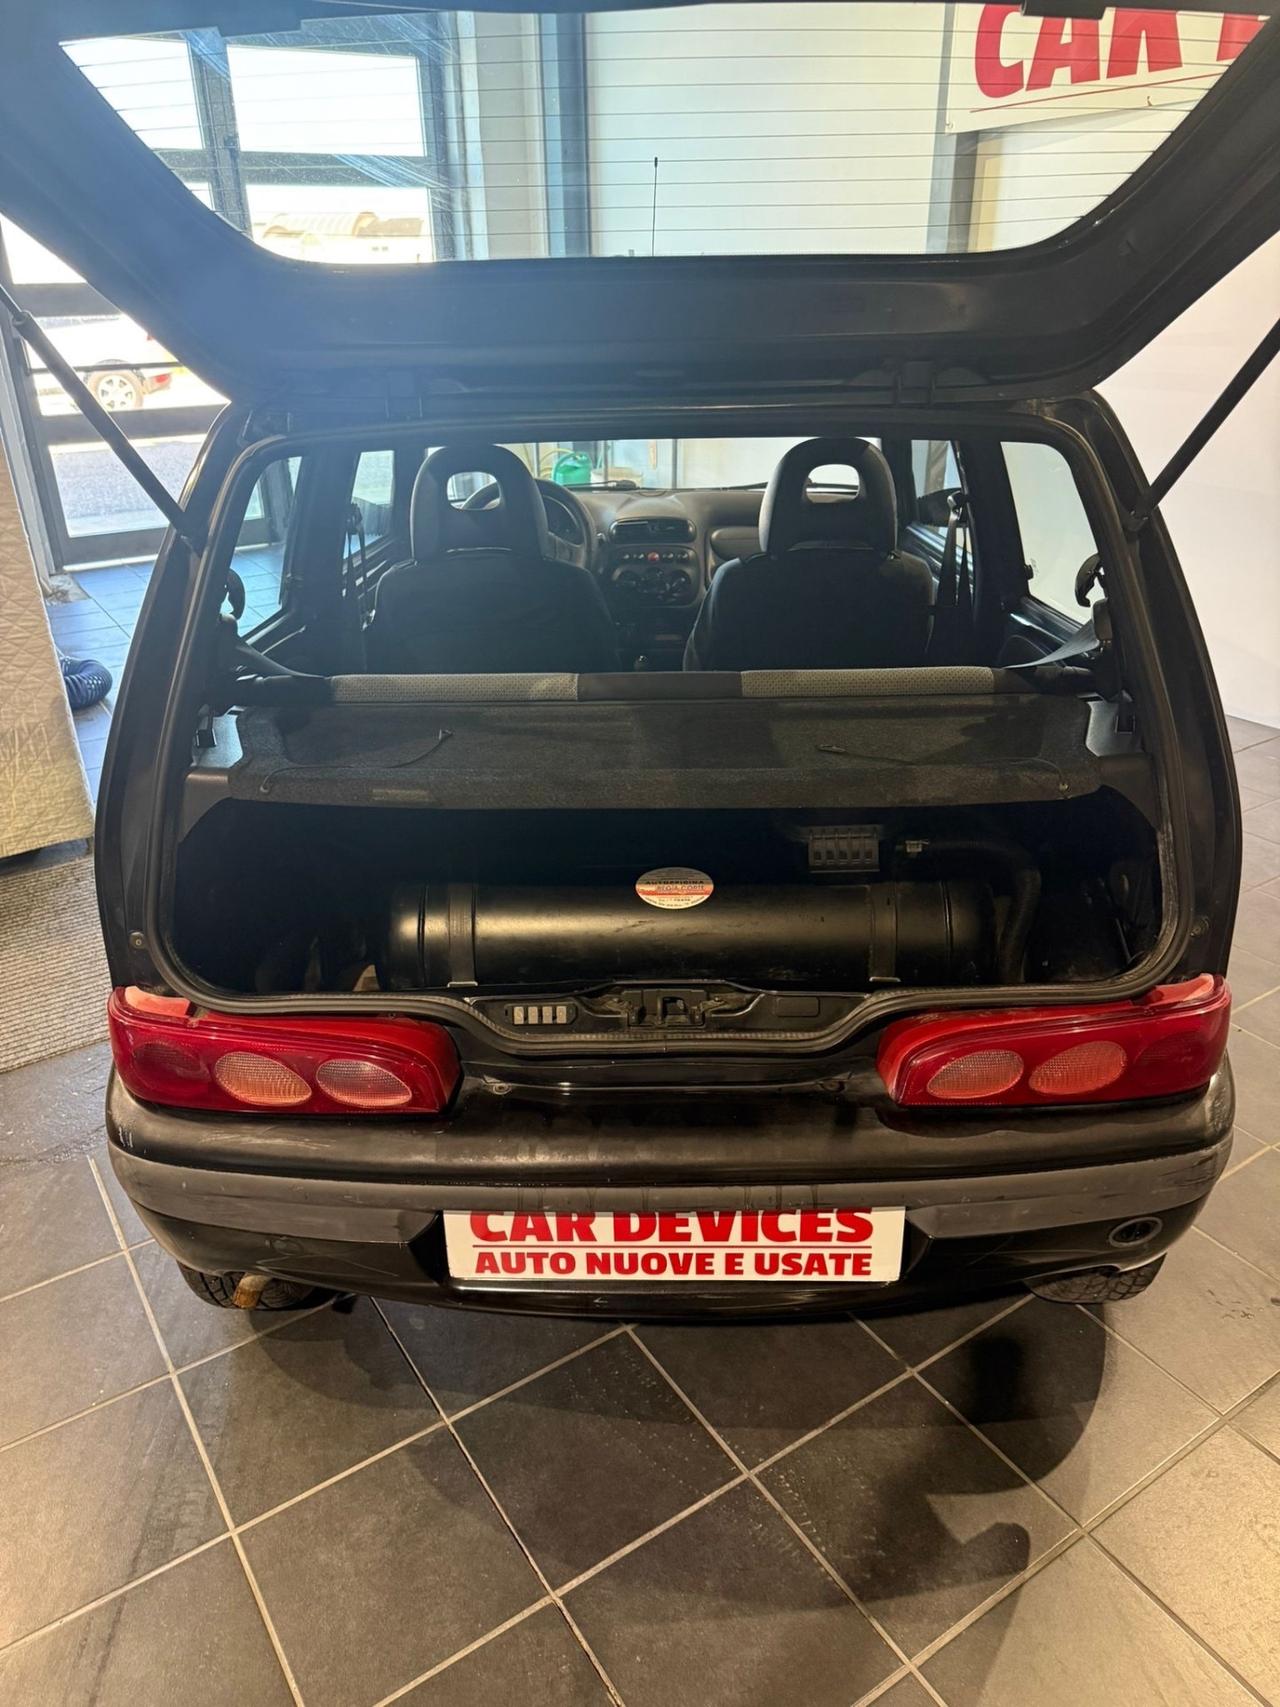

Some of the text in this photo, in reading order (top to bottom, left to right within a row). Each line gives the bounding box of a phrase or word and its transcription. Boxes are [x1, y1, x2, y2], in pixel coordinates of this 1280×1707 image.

[469, 1208, 875, 1244] CAR DEVICES
[475, 1251, 873, 1276] AUTO NUOVE E USATE
